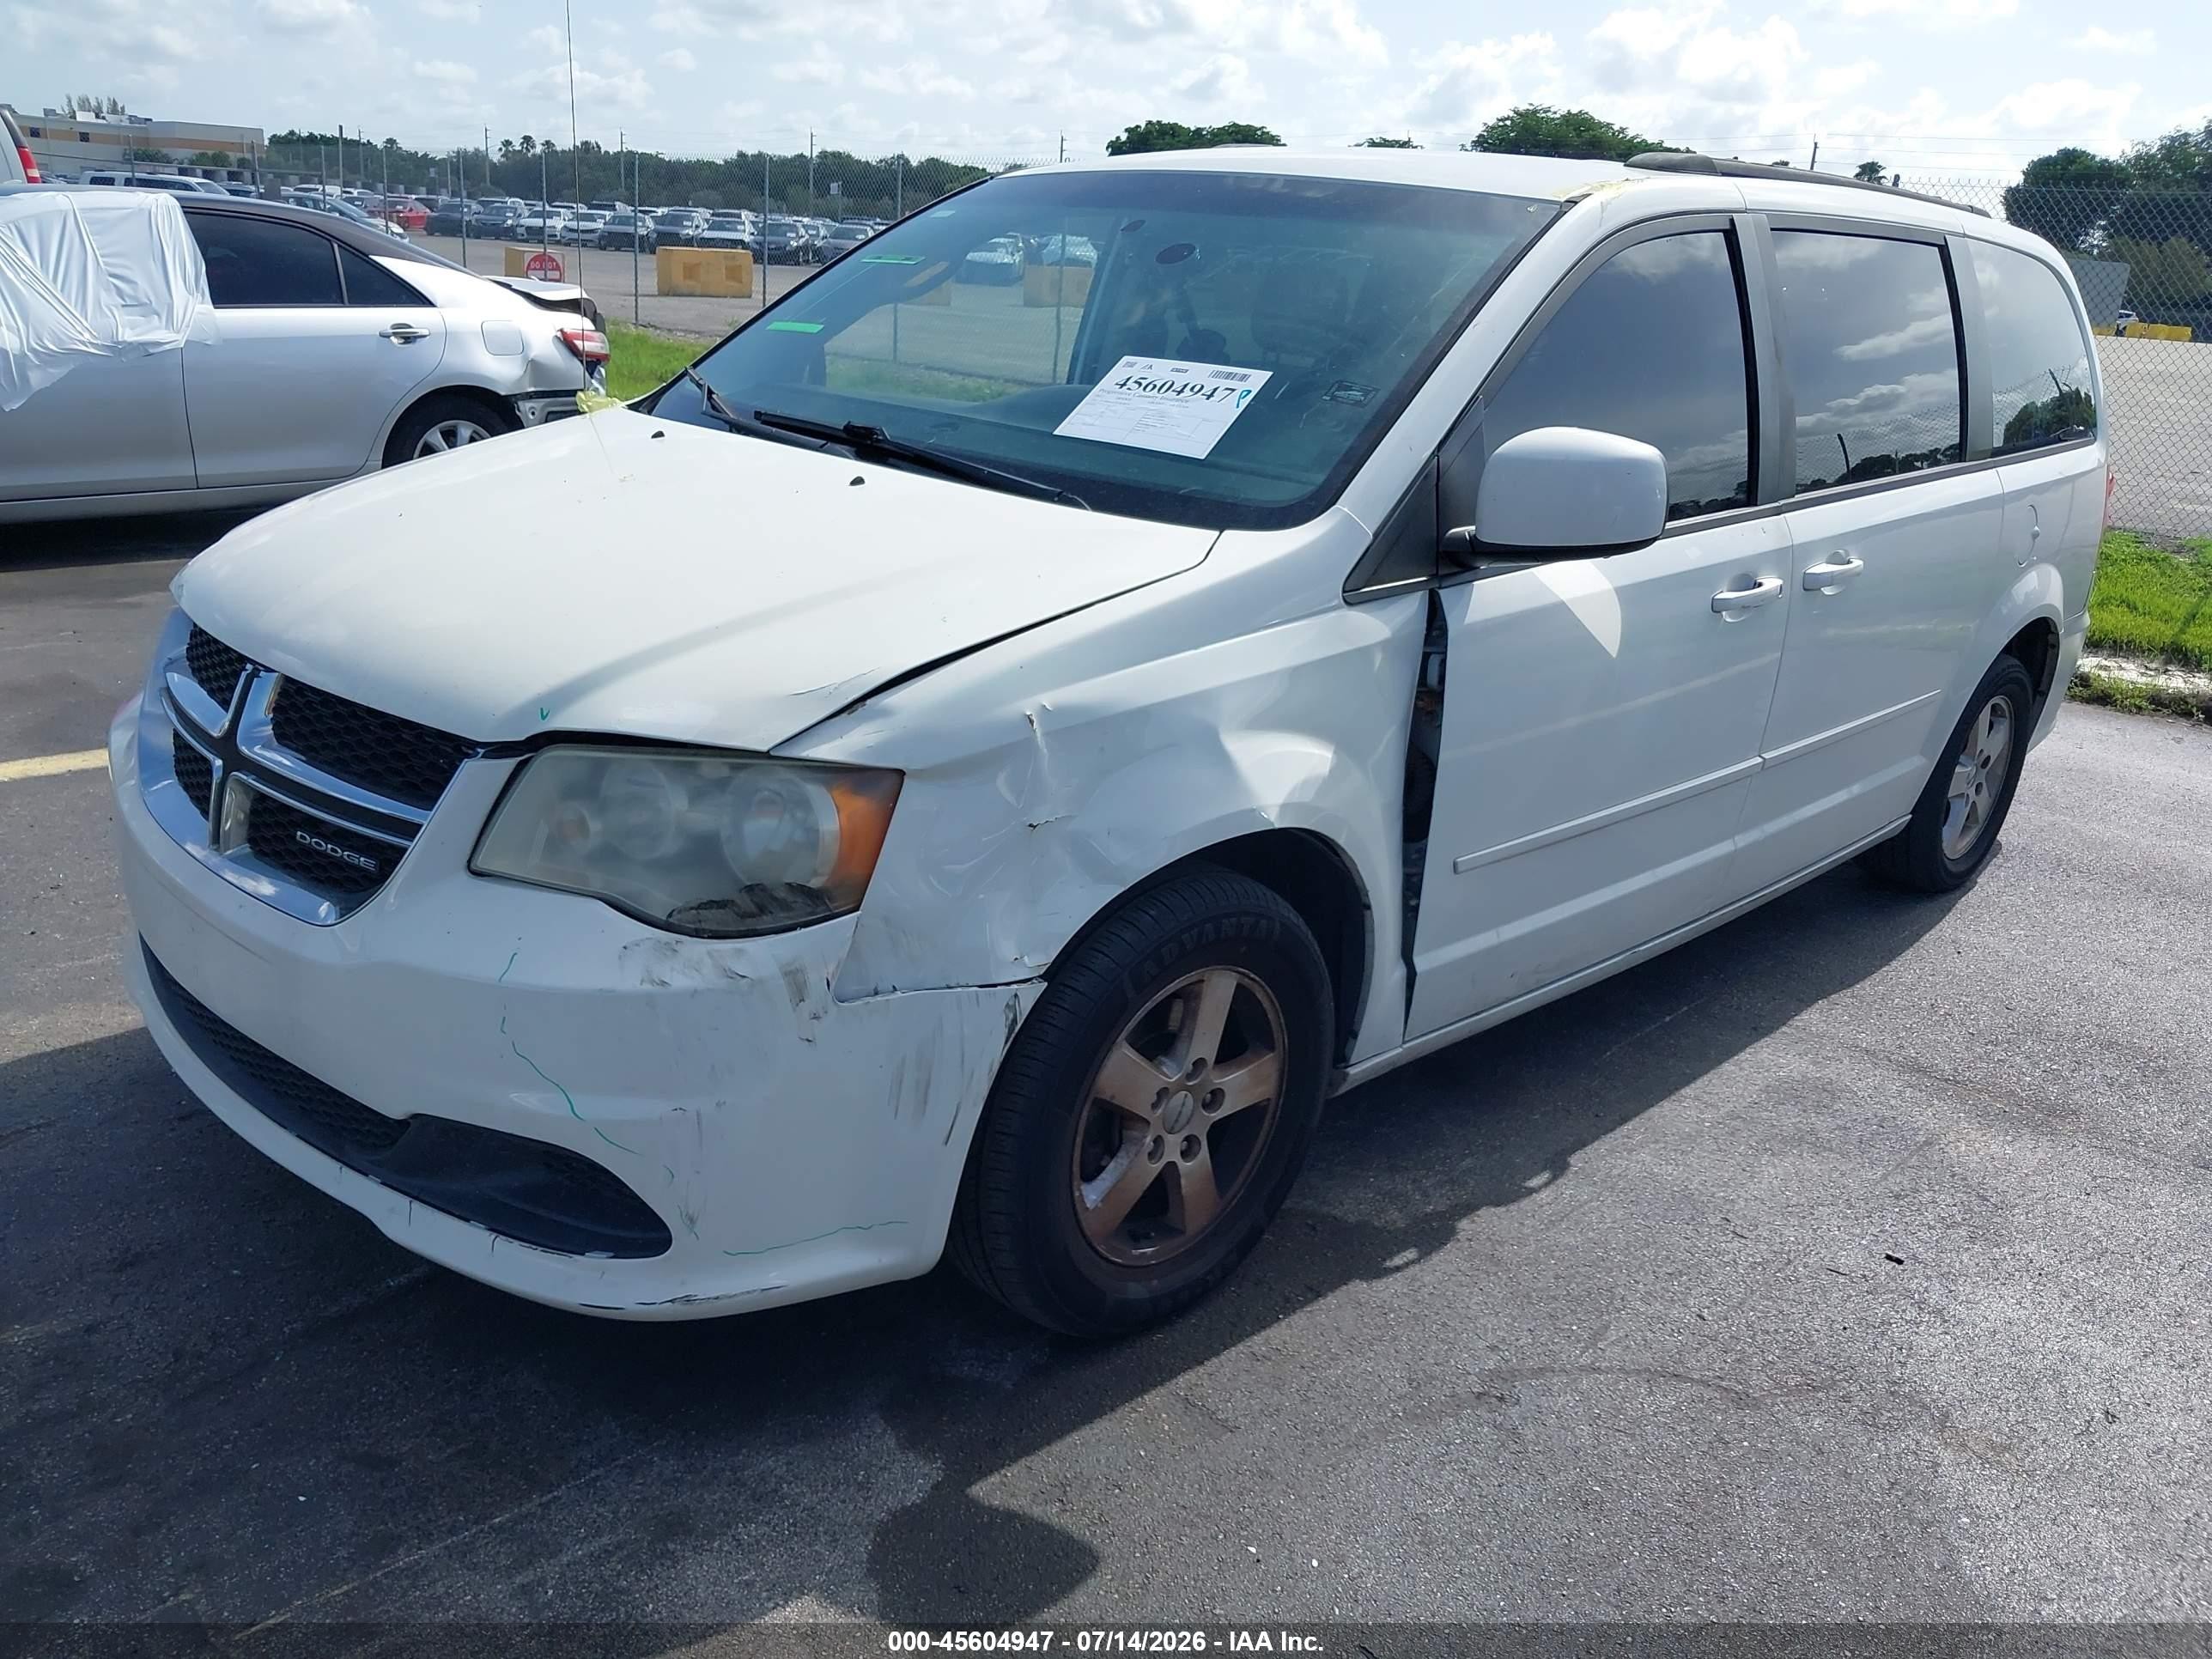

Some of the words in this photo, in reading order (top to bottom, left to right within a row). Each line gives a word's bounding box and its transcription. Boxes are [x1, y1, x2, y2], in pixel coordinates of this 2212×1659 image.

[530, 260, 541, 269] DO
[1115, 375, 1237, 403] 45604947
[295, 830, 376, 871] DODGE
